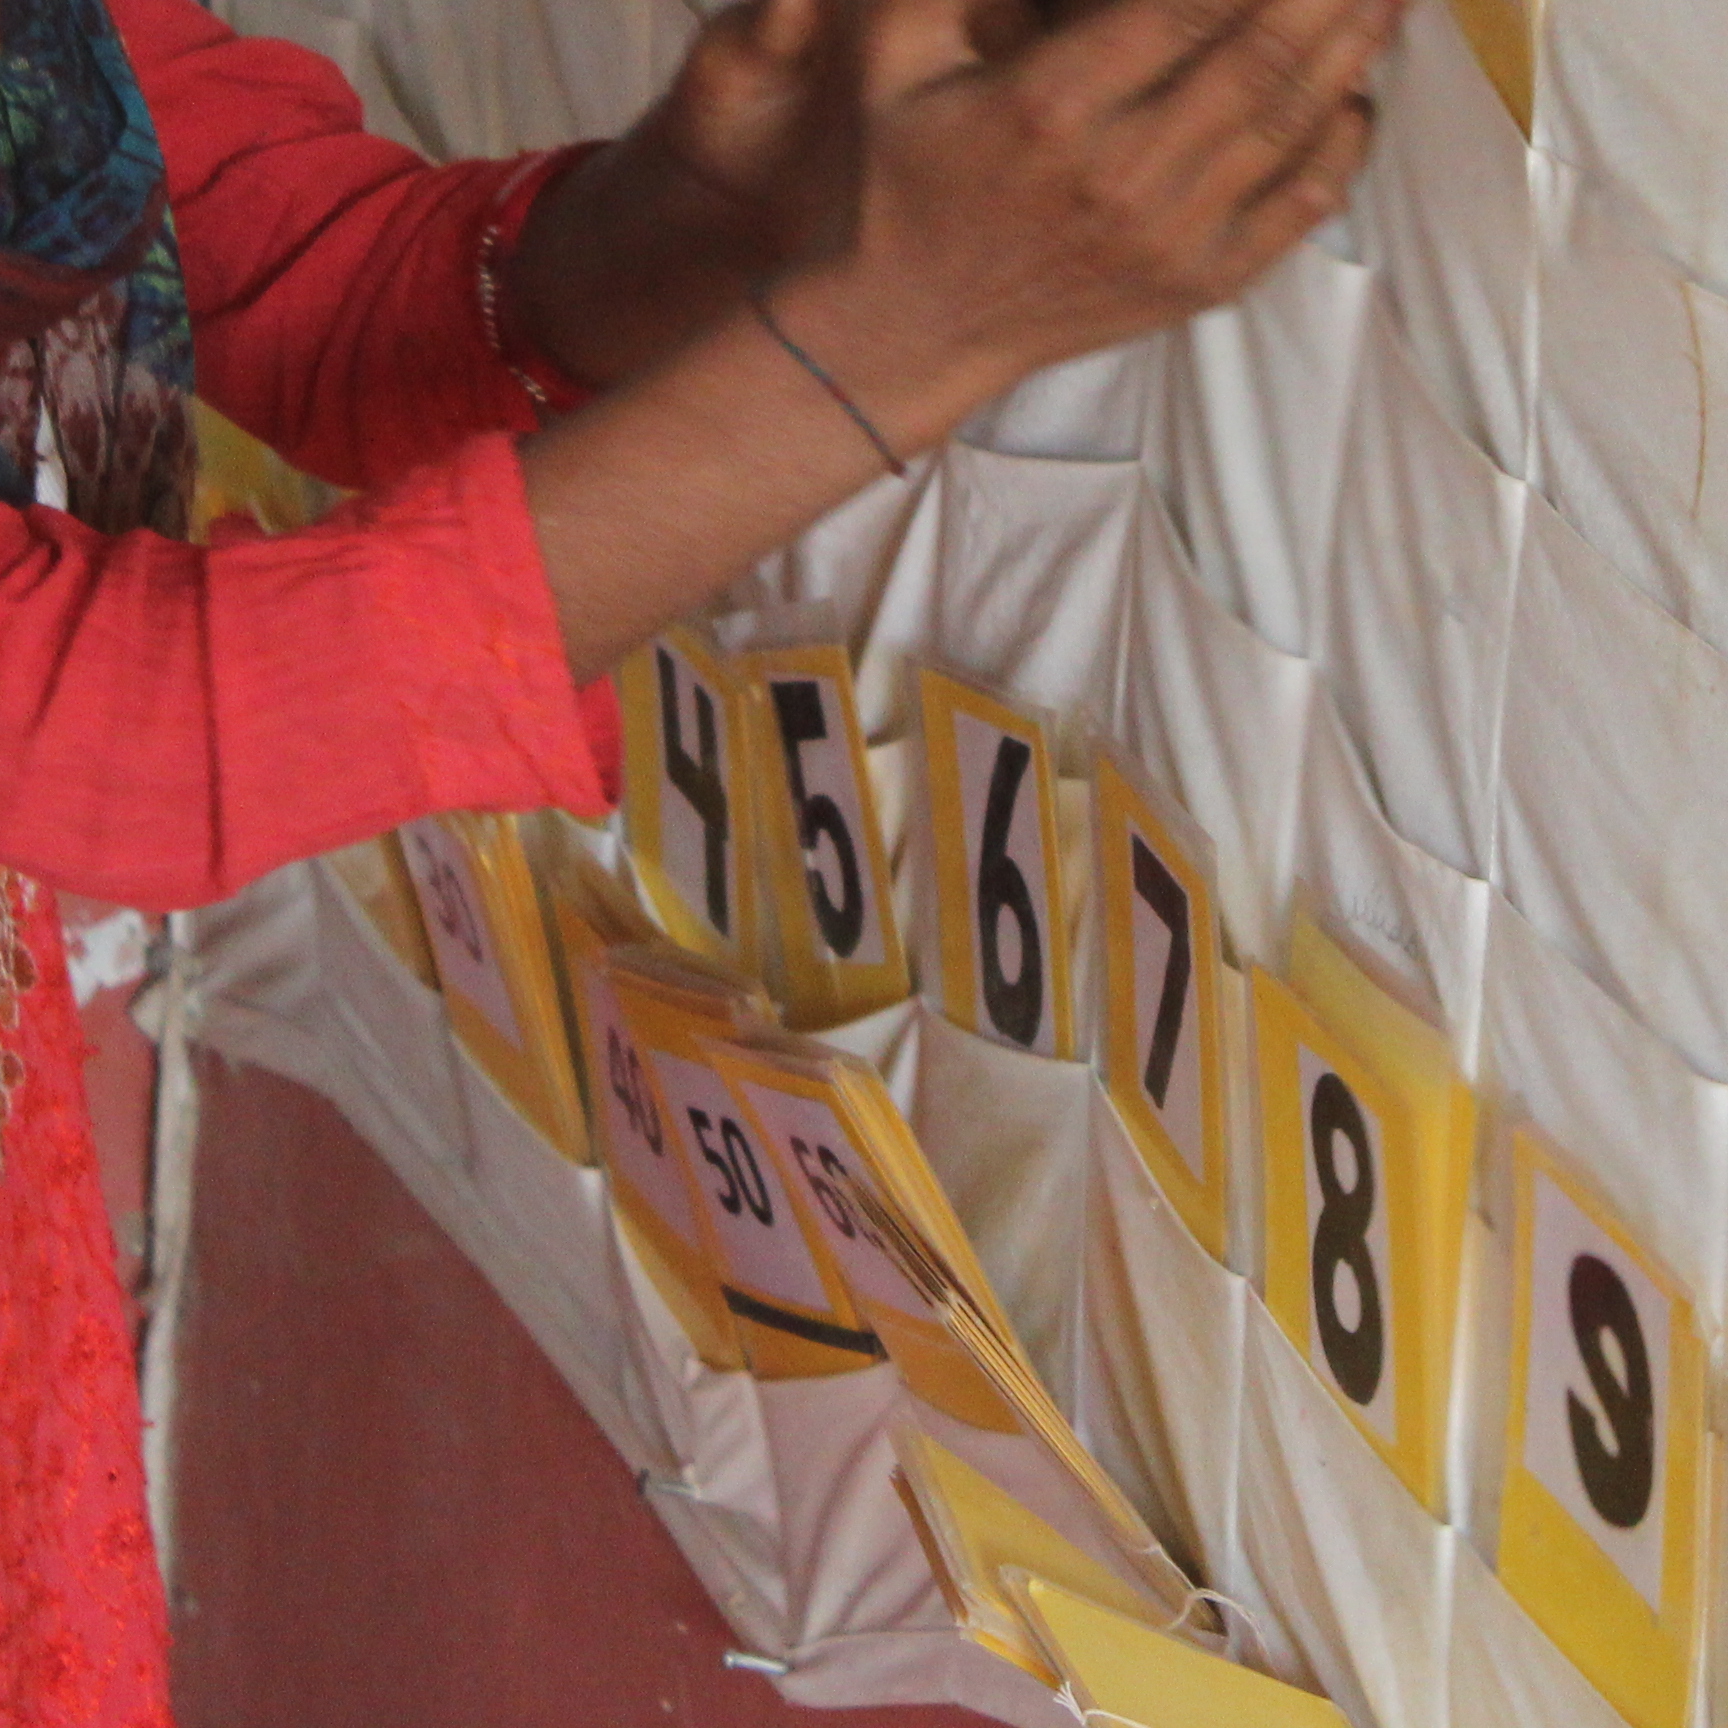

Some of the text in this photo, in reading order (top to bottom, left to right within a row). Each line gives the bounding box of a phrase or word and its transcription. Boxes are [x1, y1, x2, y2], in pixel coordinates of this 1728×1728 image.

[656, 646, 730, 940] 4
[770, 680, 865, 960] 5
[977, 735, 1043, 1048] 6
[1130, 832, 1192, 1109] 7
[686, 1105, 775, 1226] 50
[1310, 1071, 1384, 1407] 8
[1565, 1252, 1654, 1530] 9
